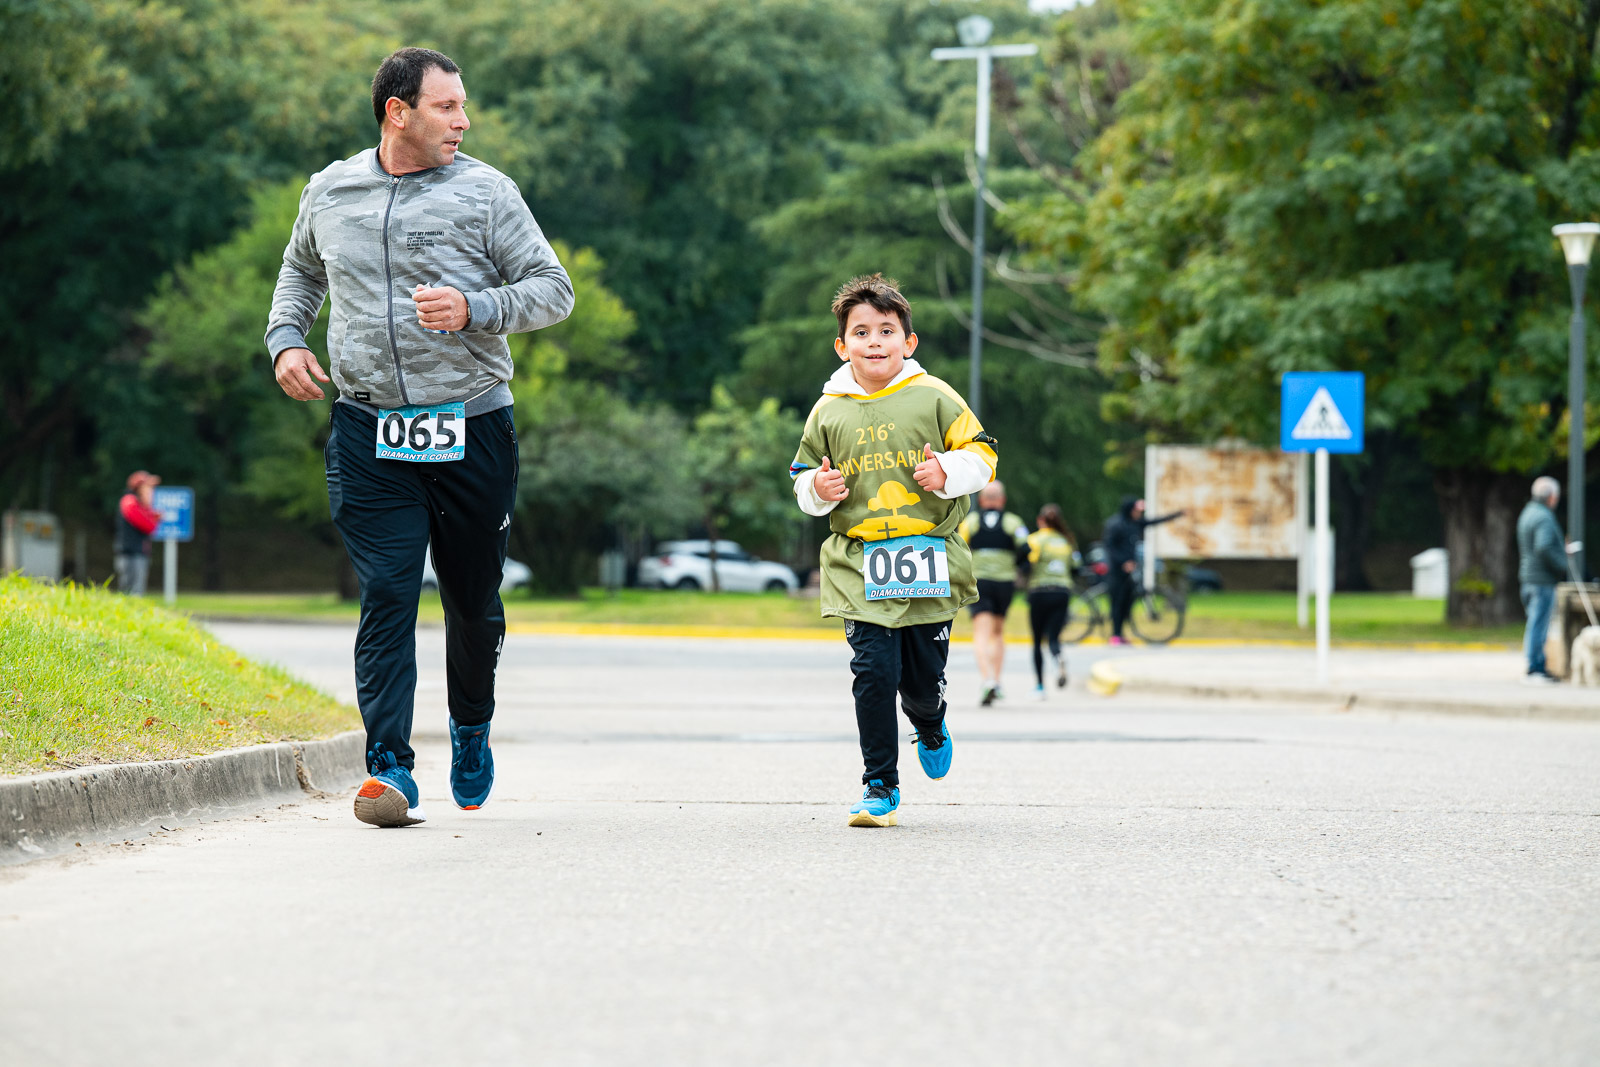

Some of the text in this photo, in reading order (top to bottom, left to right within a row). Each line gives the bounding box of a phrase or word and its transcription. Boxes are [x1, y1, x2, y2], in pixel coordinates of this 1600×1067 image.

[382, 412, 457, 451] 065
[855, 422, 896, 445] 216°
[380, 450, 460, 461] DIAMANTE CORRE
[869, 545, 937, 586] 061
[870, 587, 946, 598] DIAMANTE CORRE
